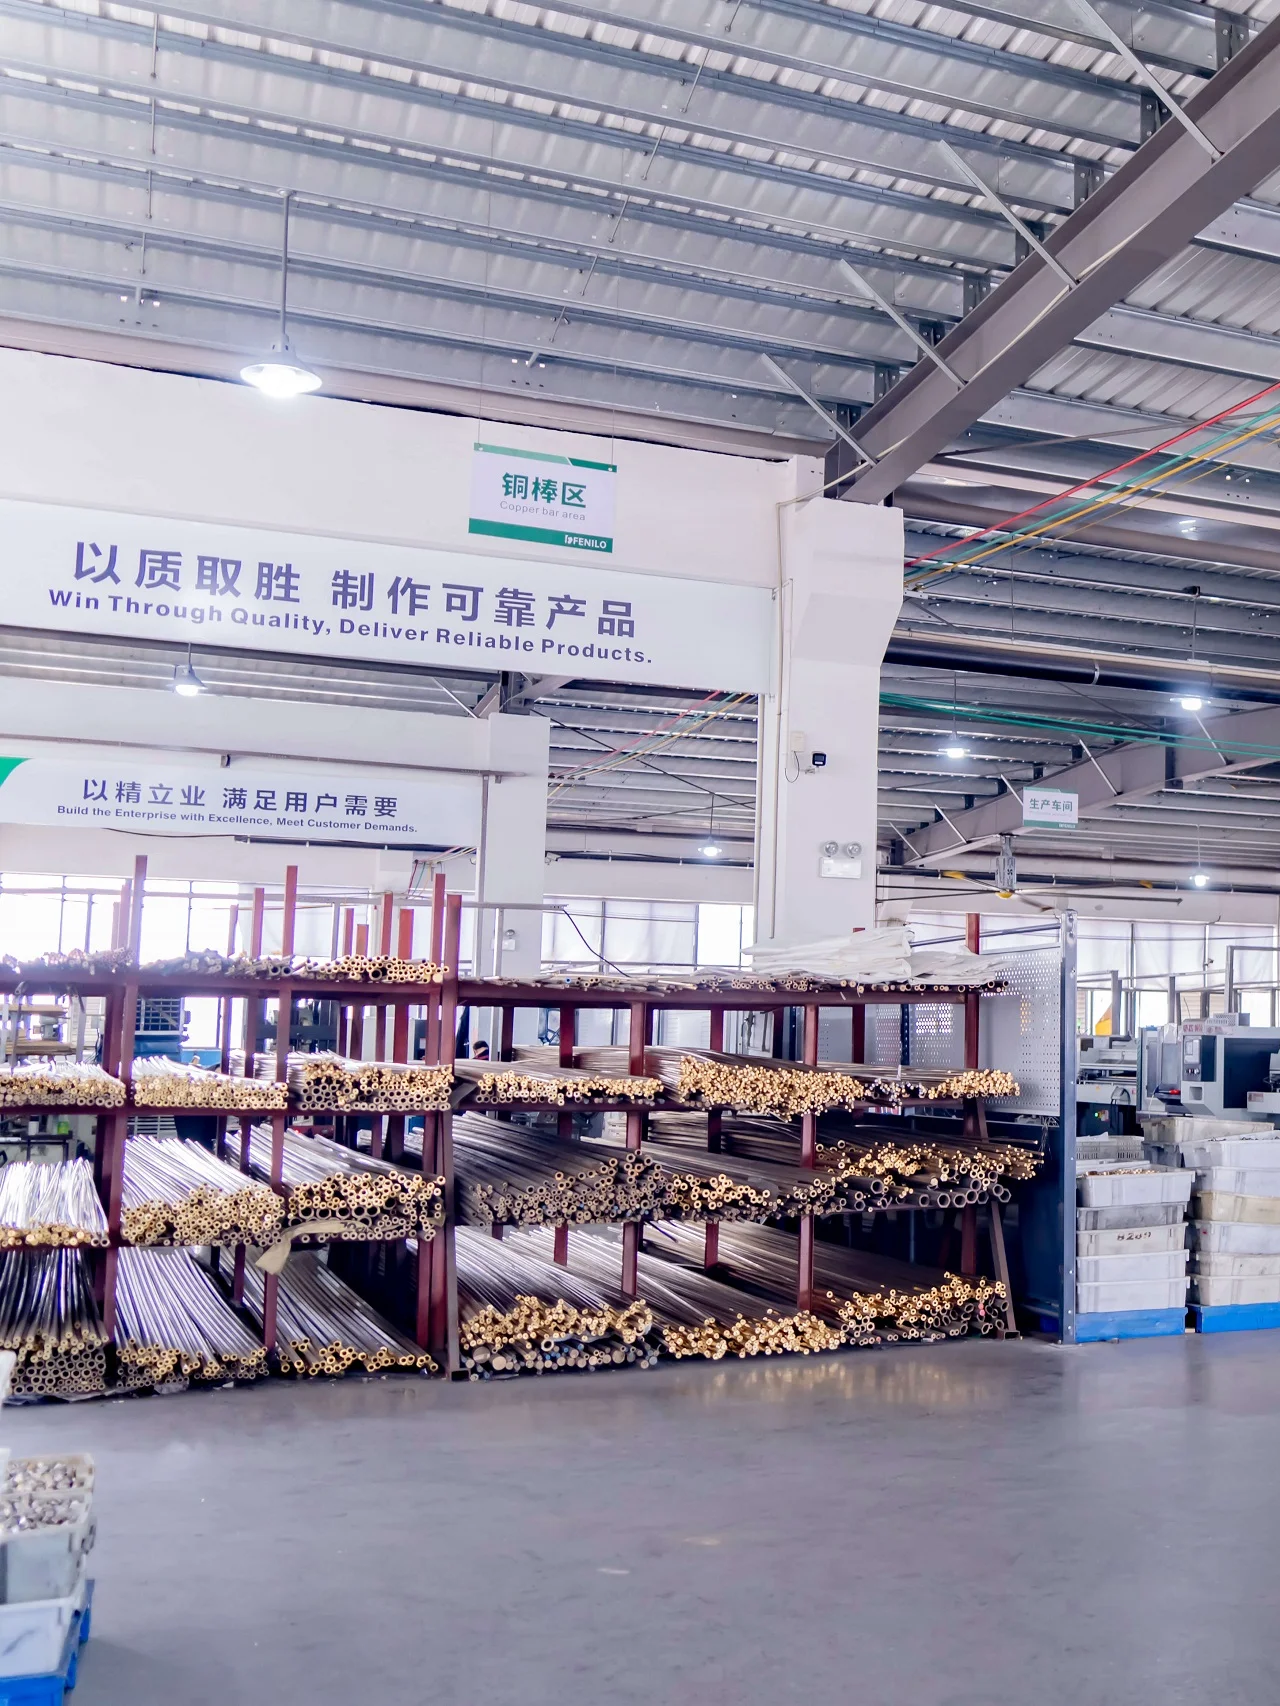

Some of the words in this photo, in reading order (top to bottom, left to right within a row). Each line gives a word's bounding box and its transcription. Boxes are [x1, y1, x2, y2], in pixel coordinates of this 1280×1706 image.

[502, 472, 587, 508] 铜棒区
[499, 500, 540, 515] Copper
[542, 506, 560, 518] bar
[561, 511, 586, 521] area
[572, 537, 607, 549] FENILO
[74, 541, 301, 604] 以质取胜
[331, 568, 636, 638] 制作可靠产品
[49, 588, 100, 610] Win
[107, 595, 223, 624] Through
[230, 607, 332, 636] Quality,
[339, 618, 430, 642] Deliver
[435, 628, 535, 653] Reliable
[541, 638, 653, 664] Products.
[82, 778, 206, 807] 以精立业
[222, 787, 398, 818] 满足用户需要
[1029, 798, 1073, 812] 生产车间
[57, 805, 89, 816] Build
[92, 807, 112, 817] the
[115, 808, 177, 821] Enterprise
[180, 812, 205, 822] with
[208, 813, 273, 826] Excellence,
[276, 817, 305, 828] Meet
[307, 818, 362, 831] Customer
[364, 821, 418, 834] Demands.
